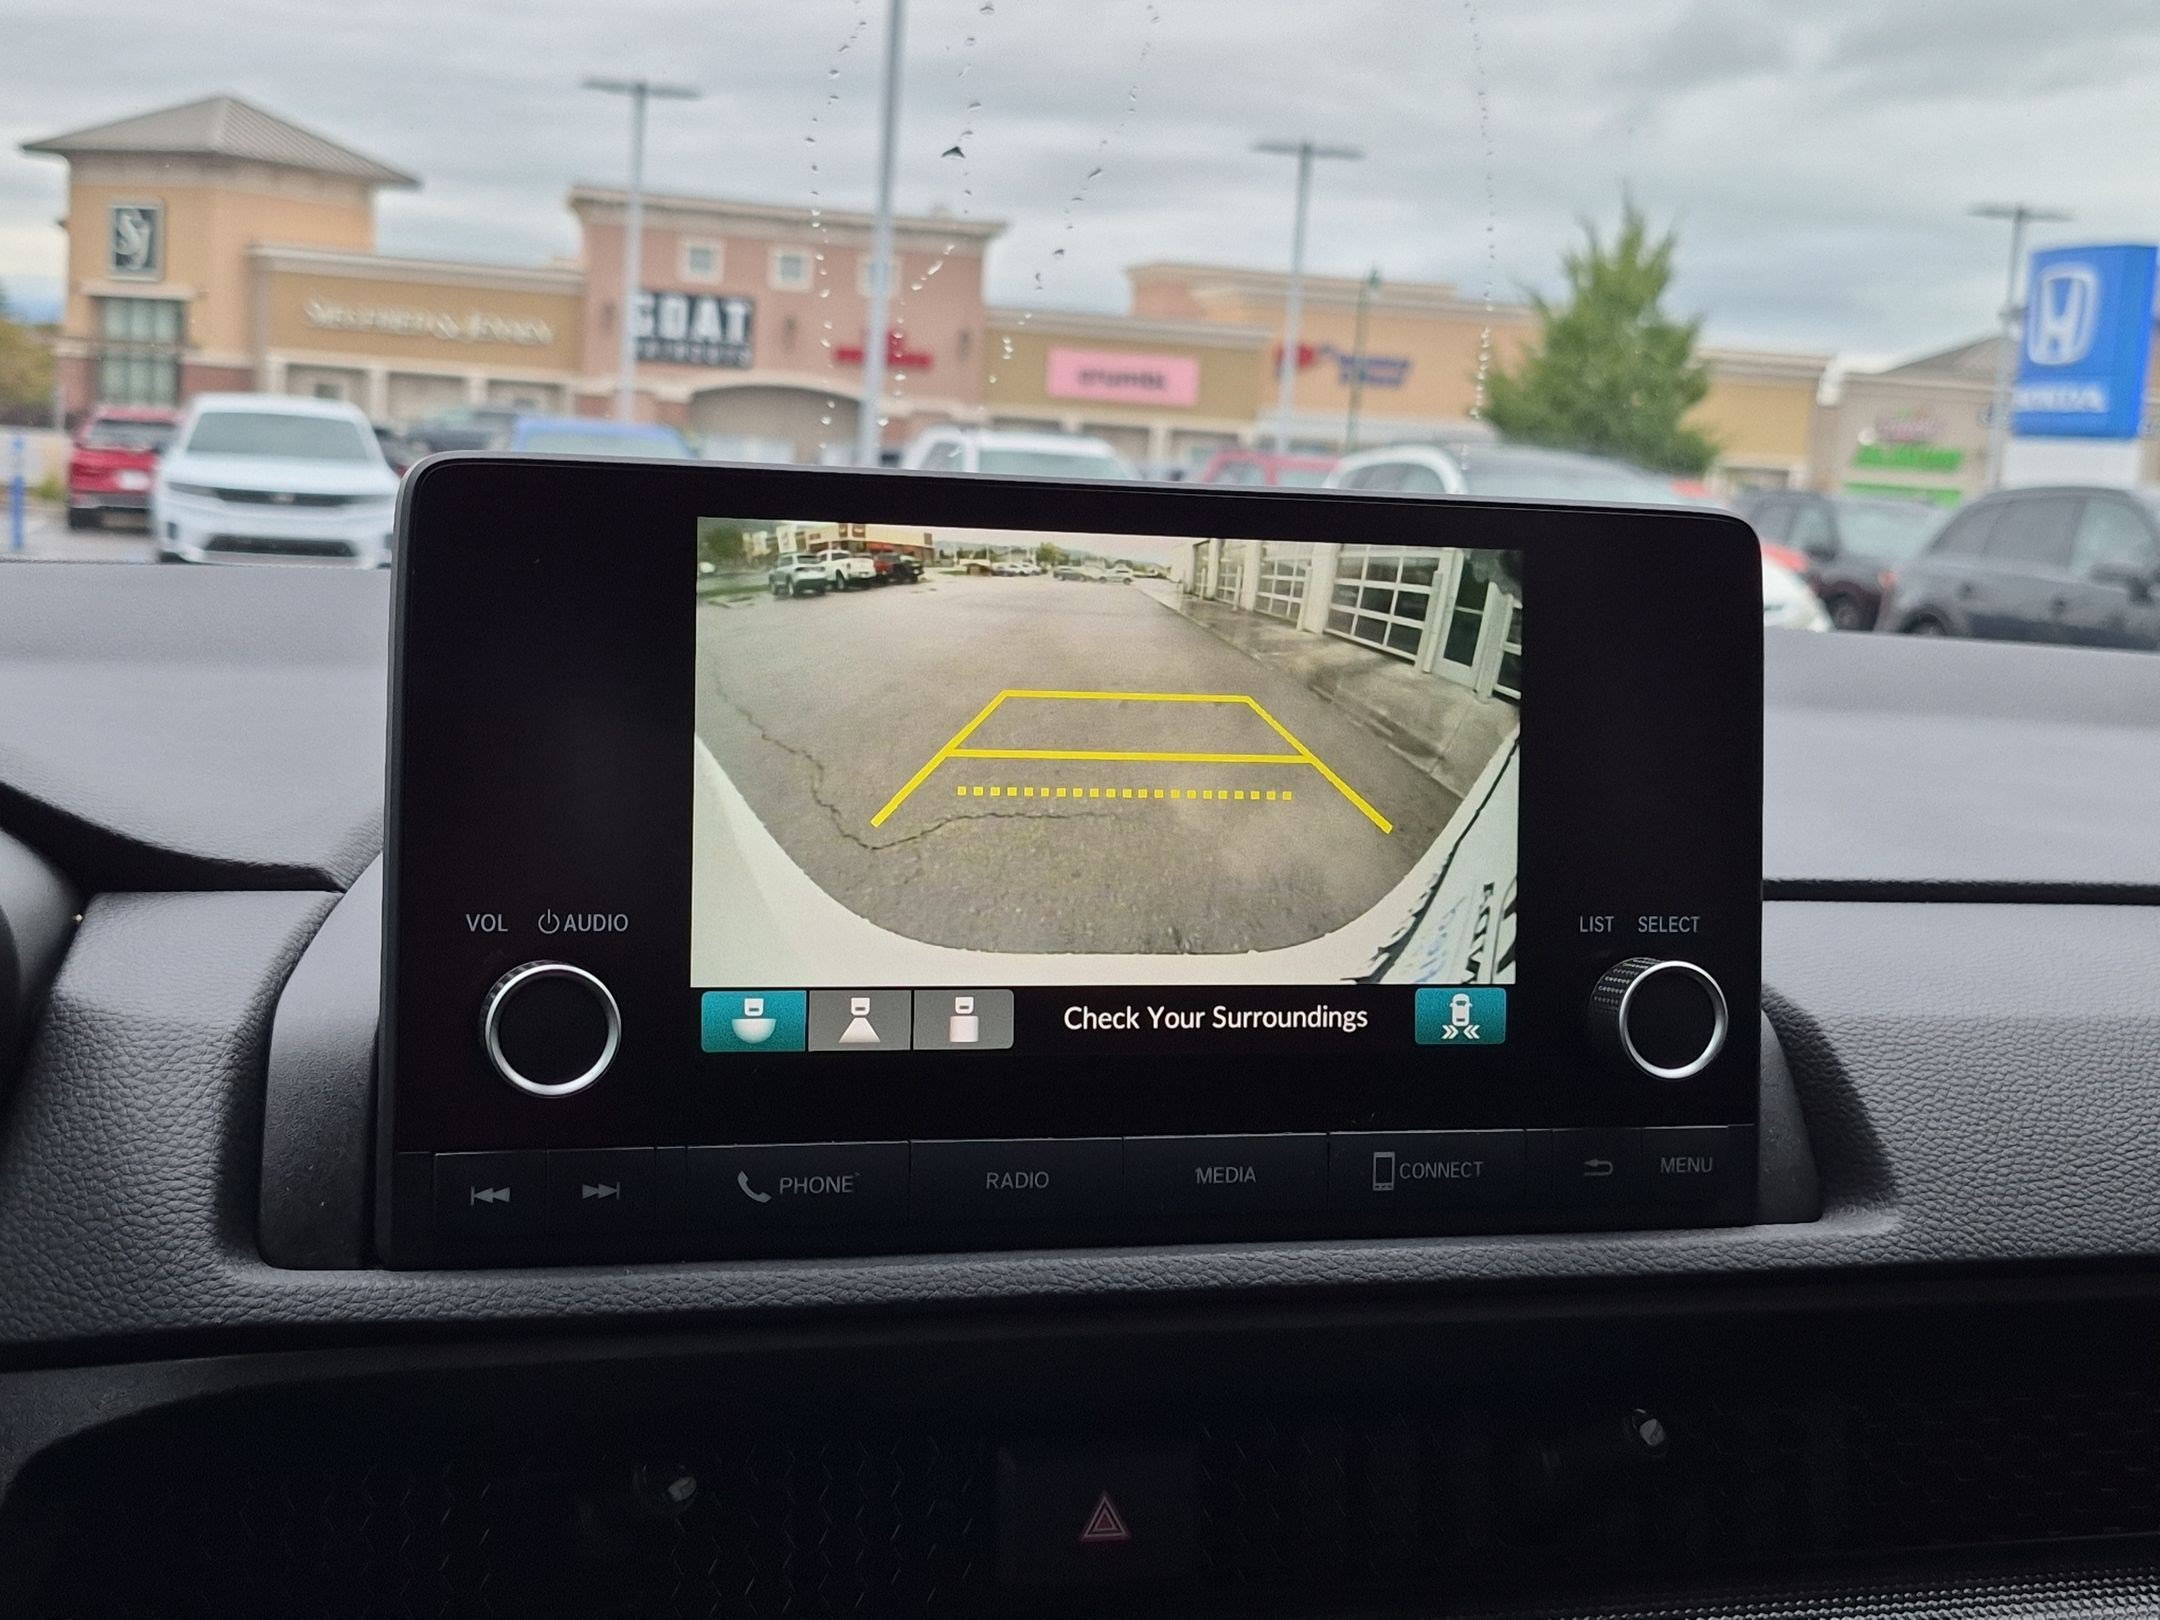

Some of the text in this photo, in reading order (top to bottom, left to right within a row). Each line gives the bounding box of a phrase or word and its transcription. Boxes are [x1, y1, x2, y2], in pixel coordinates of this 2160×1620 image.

[465, 913, 509, 933] VOL
[563, 913, 629, 933] AUDIO
[1579, 915, 1615, 933] LIST
[1637, 915, 1701, 933] SELECT
[1063, 1004, 1369, 1032] Check Your Surroundings
[1399, 1160, 1484, 1180] CONNECT
[1659, 1156, 1714, 1174] MENU
[778, 1174, 853, 1195] PHONE
[985, 1171, 1050, 1190] RADIO
[1195, 1166, 1257, 1184] MEDIA
